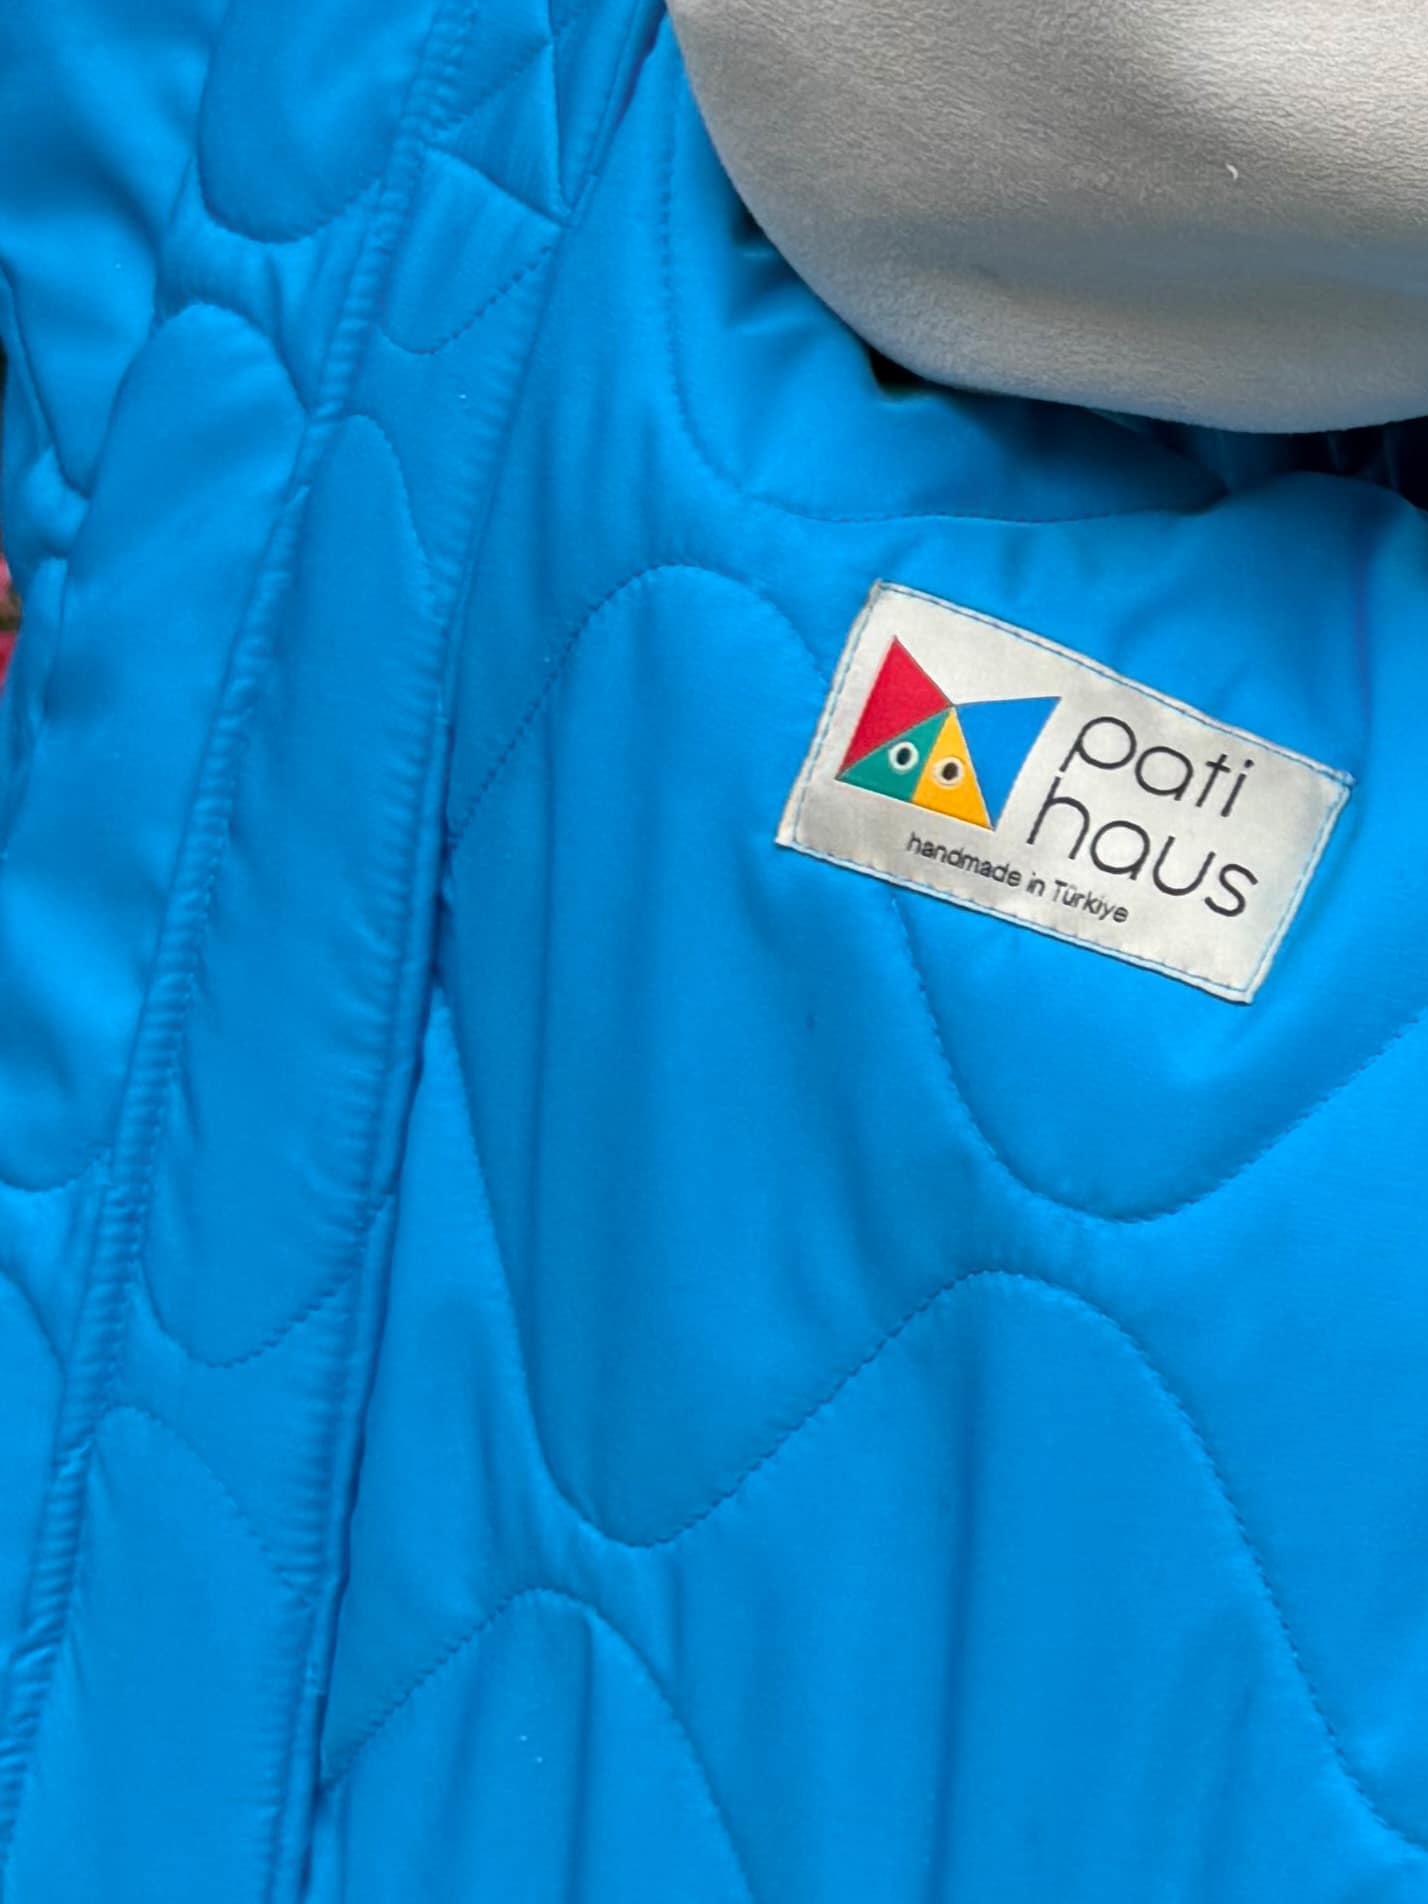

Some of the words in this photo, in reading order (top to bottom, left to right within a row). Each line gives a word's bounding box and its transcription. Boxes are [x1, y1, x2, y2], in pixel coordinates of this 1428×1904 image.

[1059, 715, 1255, 818] pati
[906, 831, 1022, 888] handmade
[1026, 871, 1046, 897] in
[1052, 879, 1130, 924] Türkiye
[1026, 776, 1259, 918] haus
